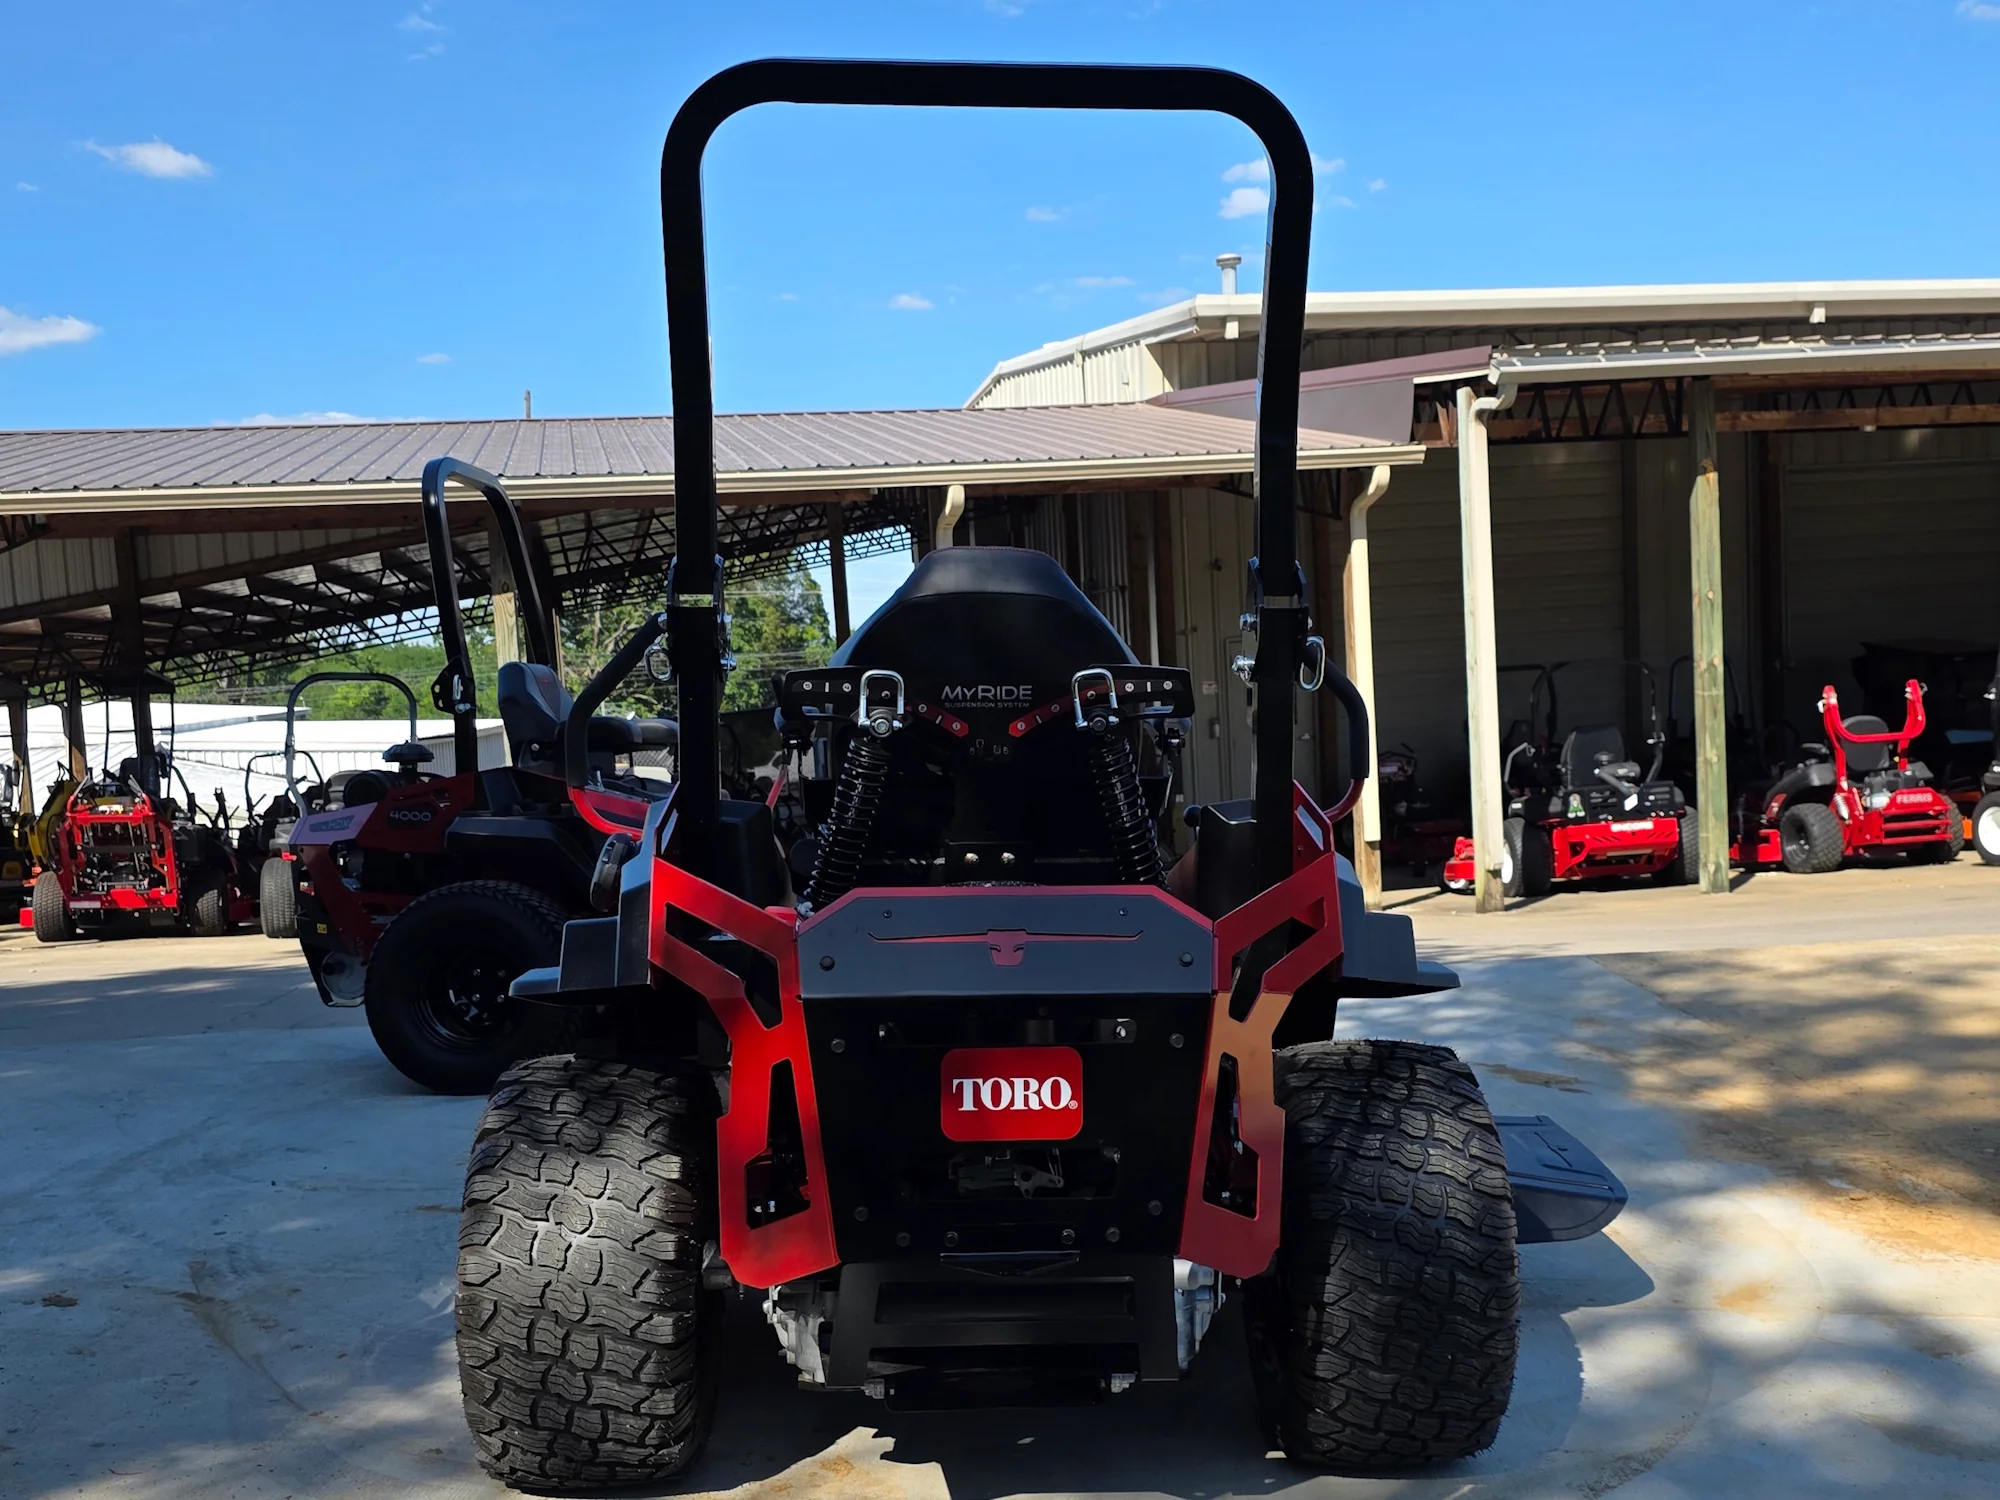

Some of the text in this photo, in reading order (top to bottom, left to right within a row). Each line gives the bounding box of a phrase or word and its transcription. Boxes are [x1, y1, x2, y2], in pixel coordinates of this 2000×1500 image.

[944, 701, 1030, 709] SUSPENSION SYSTEM
[389, 810, 431, 821] 4000
[952, 1076, 1073, 1111] TORO
